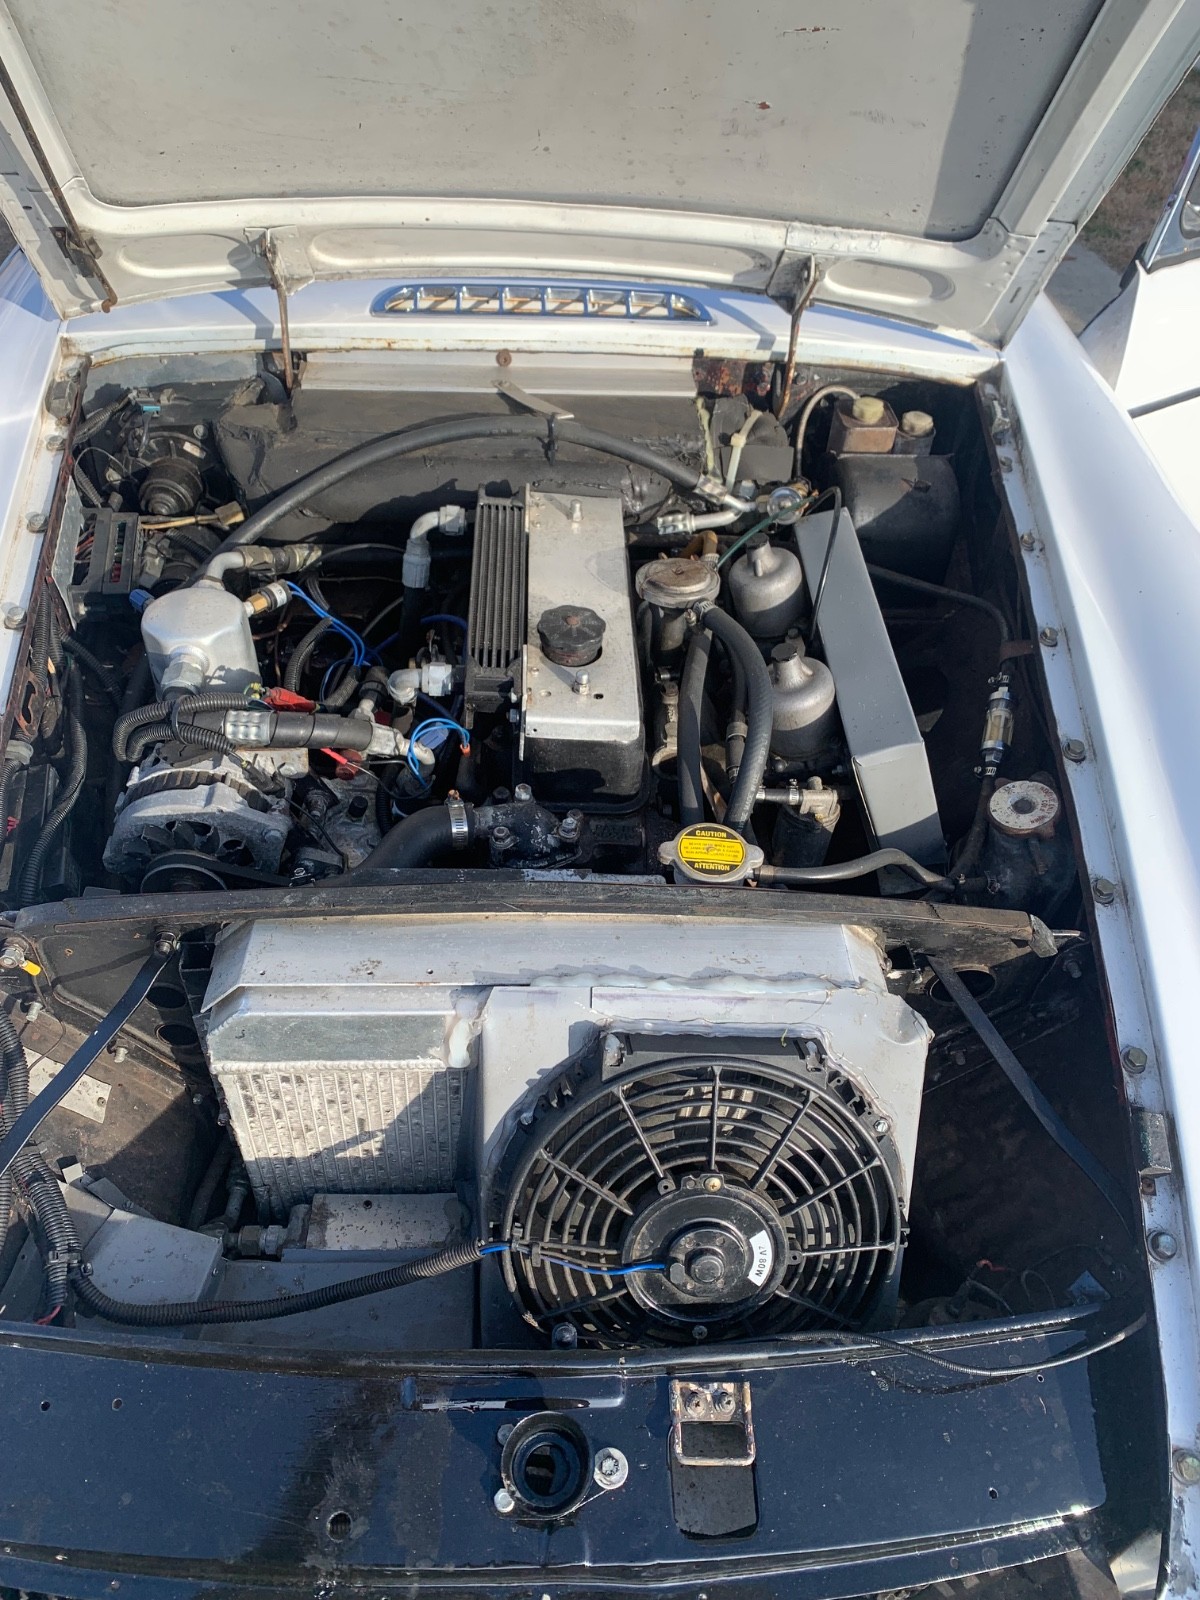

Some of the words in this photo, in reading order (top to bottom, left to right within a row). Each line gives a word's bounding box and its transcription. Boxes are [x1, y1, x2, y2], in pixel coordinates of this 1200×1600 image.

[695, 830, 727, 838] CAUTION
[694, 862, 730, 871] ATTENTION
[755, 1258, 767, 1278] 80W
